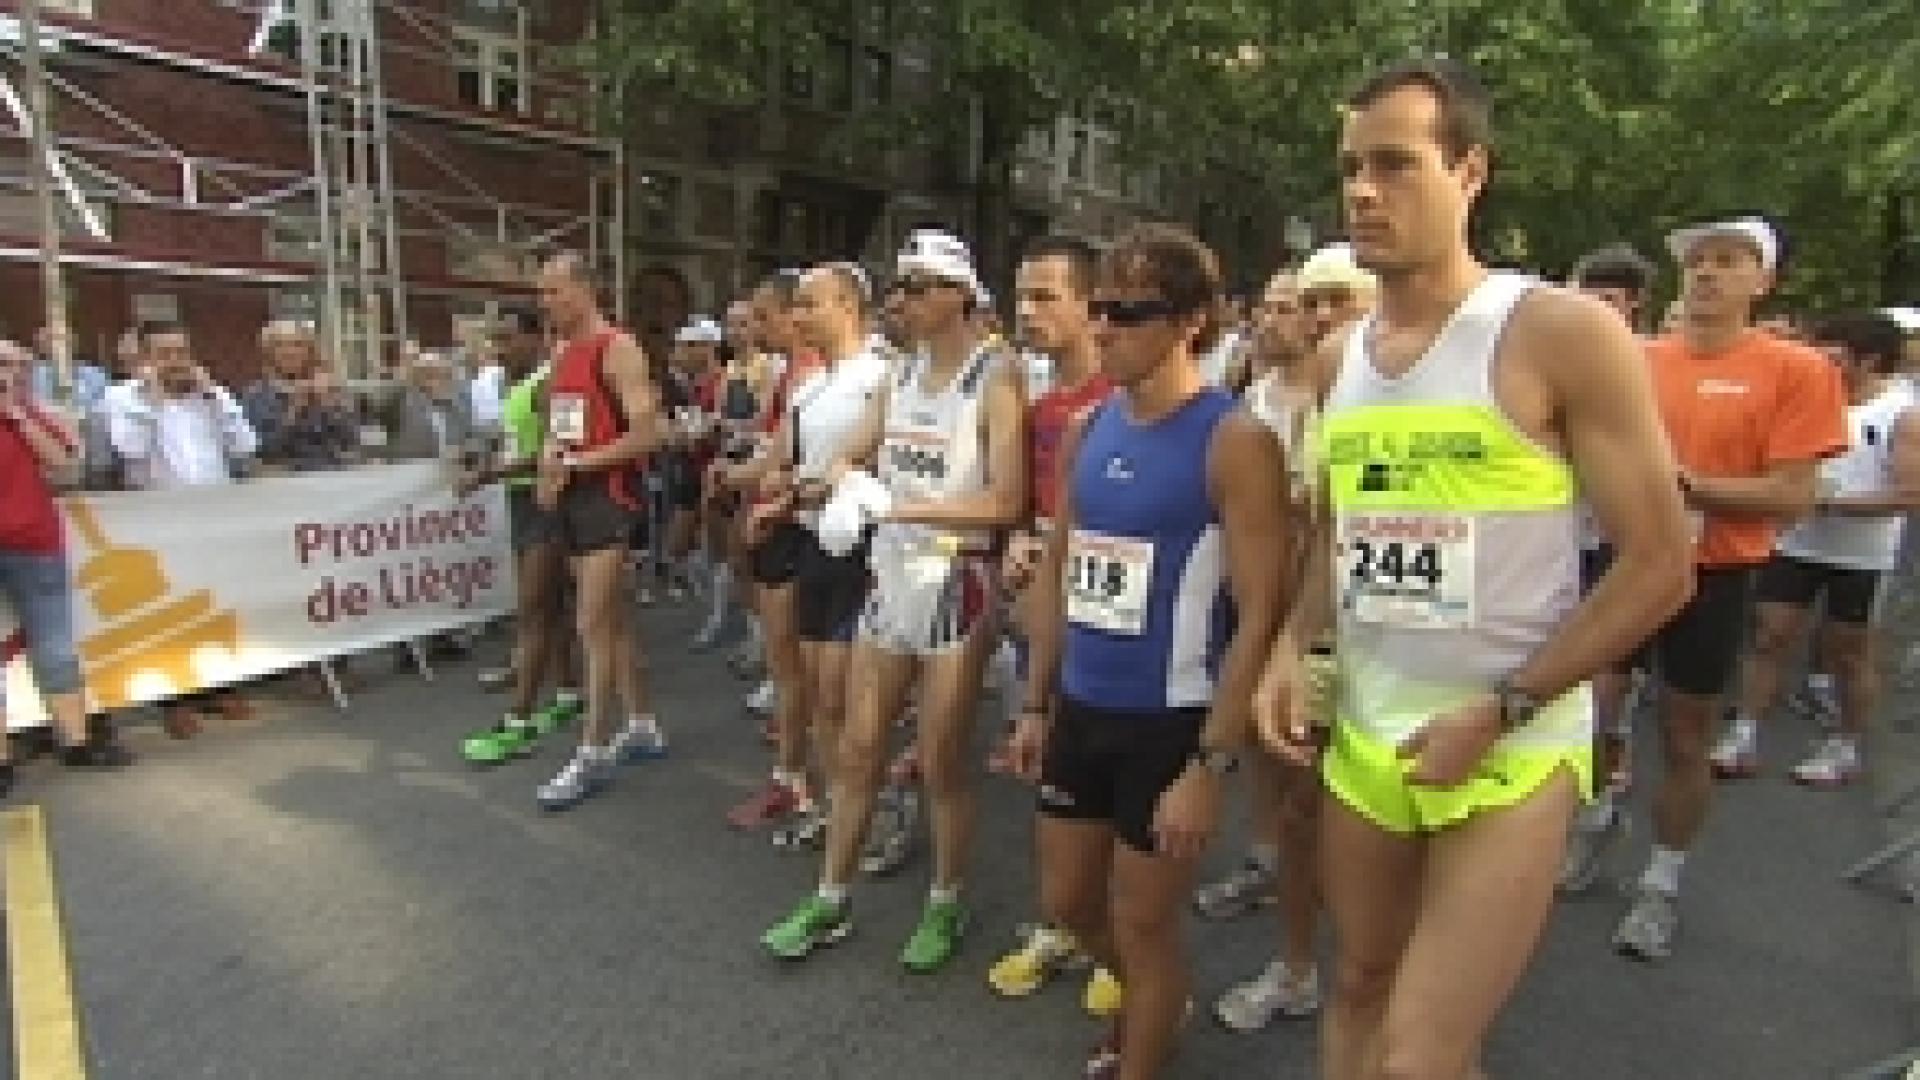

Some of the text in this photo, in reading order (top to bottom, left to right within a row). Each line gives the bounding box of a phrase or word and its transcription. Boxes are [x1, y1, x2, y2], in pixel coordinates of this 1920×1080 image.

[294, 503, 487, 564] Province
[1351, 540, 1442, 583] 244
[306, 556, 495, 625] de Liège
